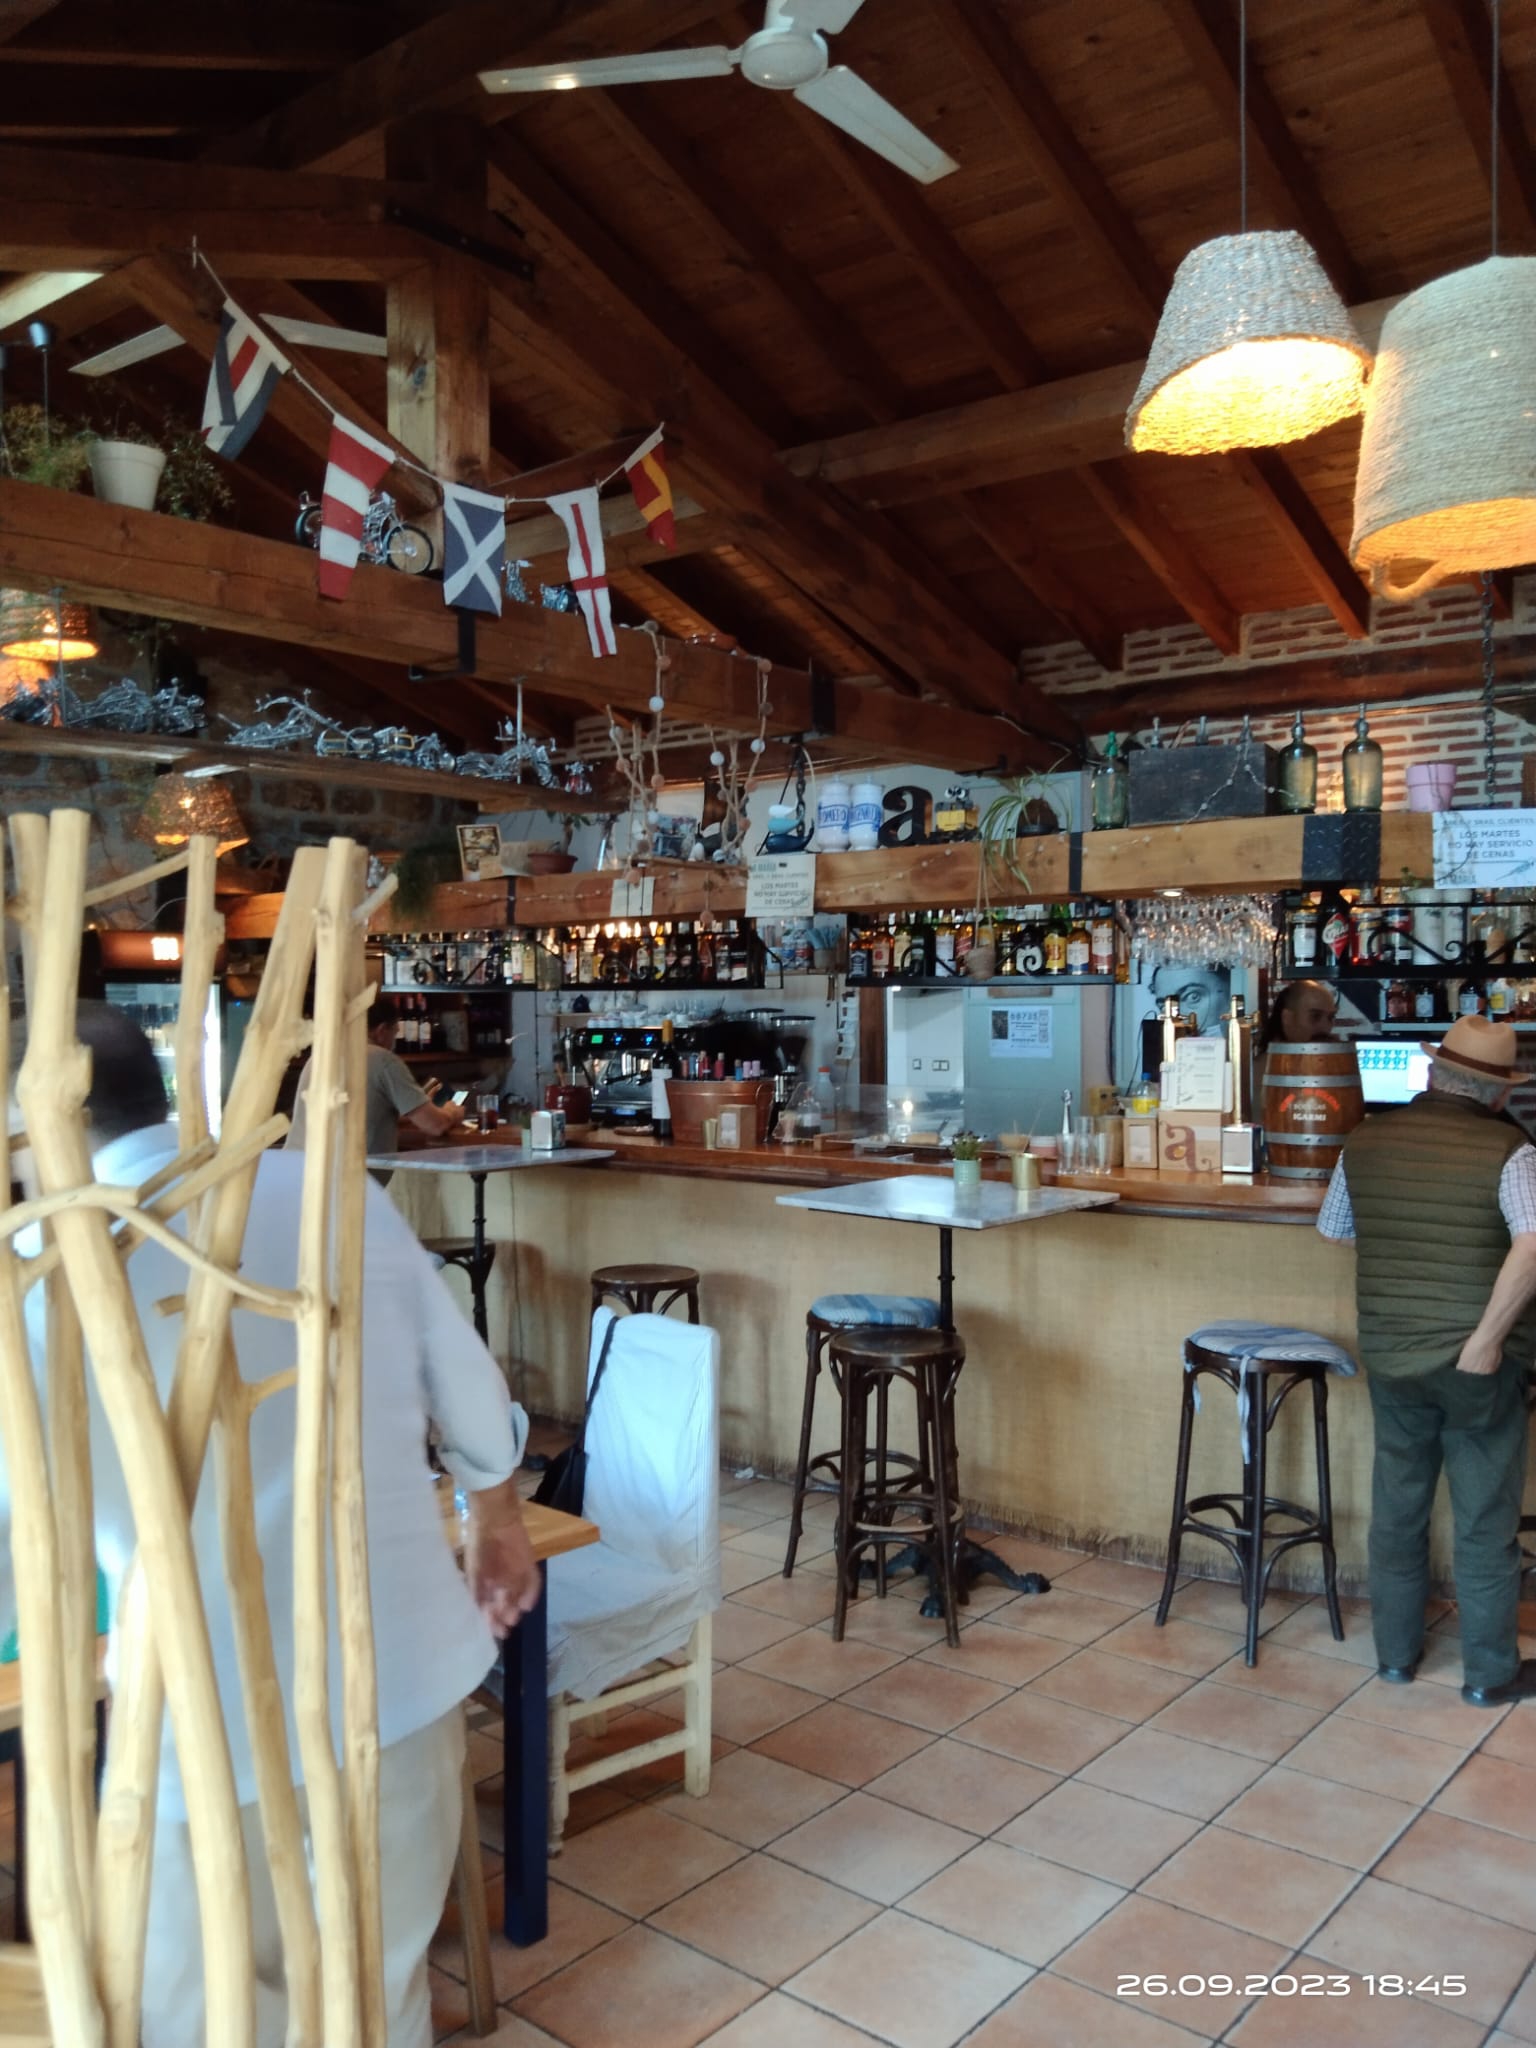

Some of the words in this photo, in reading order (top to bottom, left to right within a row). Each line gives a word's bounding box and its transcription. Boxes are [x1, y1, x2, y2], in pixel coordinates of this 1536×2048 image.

[878, 785, 932, 847] a
[1460, 831, 1478, 839] LOS
[1481, 830, 1520, 838] MARTES
[1488, 840, 1533, 848] SERVICIO
